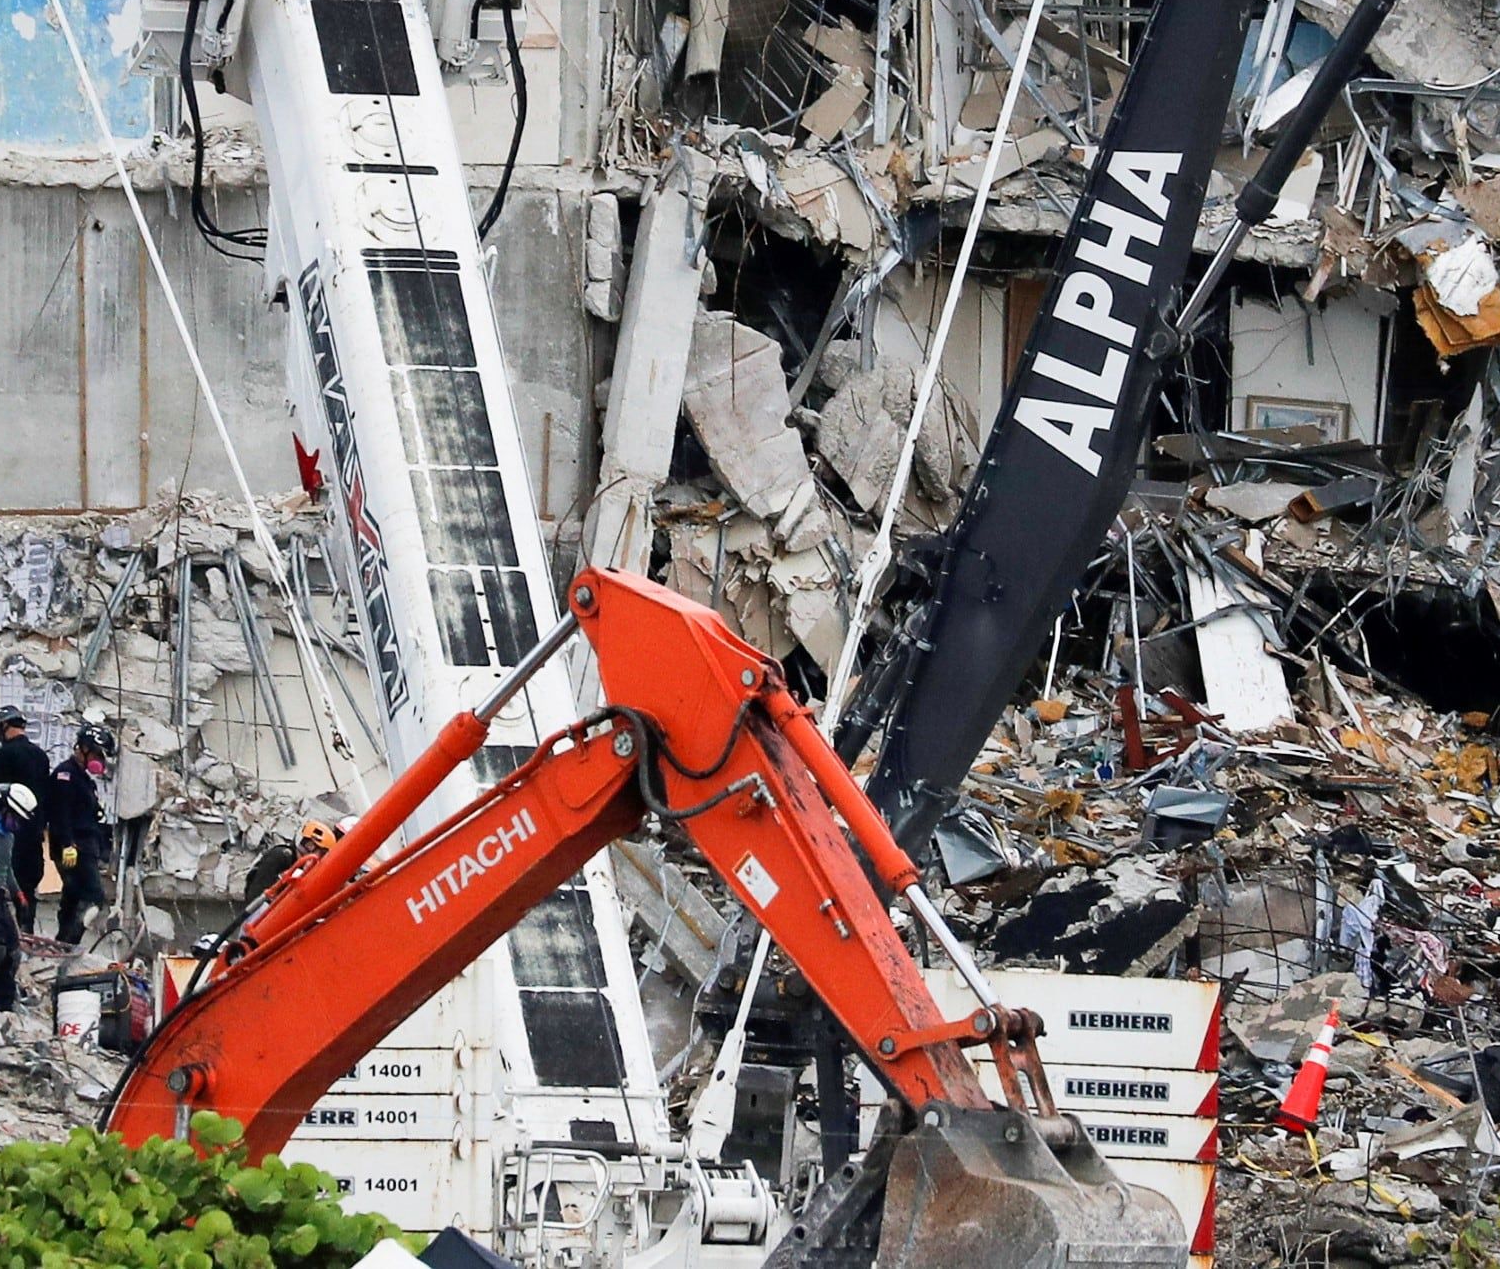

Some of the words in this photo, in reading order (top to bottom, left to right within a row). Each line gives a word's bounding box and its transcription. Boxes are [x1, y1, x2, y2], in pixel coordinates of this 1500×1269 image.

[1013, 150, 1184, 478] ALPHA
[405, 808, 537, 924] HITACHI
[1070, 1013, 1170, 1031] LIEBHERR
[368, 1064, 422, 1078] 14001
[1066, 1081, 1168, 1100] LIEBHERR
[304, 1110, 355, 1125] ERR
[365, 1110, 418, 1124] 14001
[365, 1178, 418, 1192] 14001
